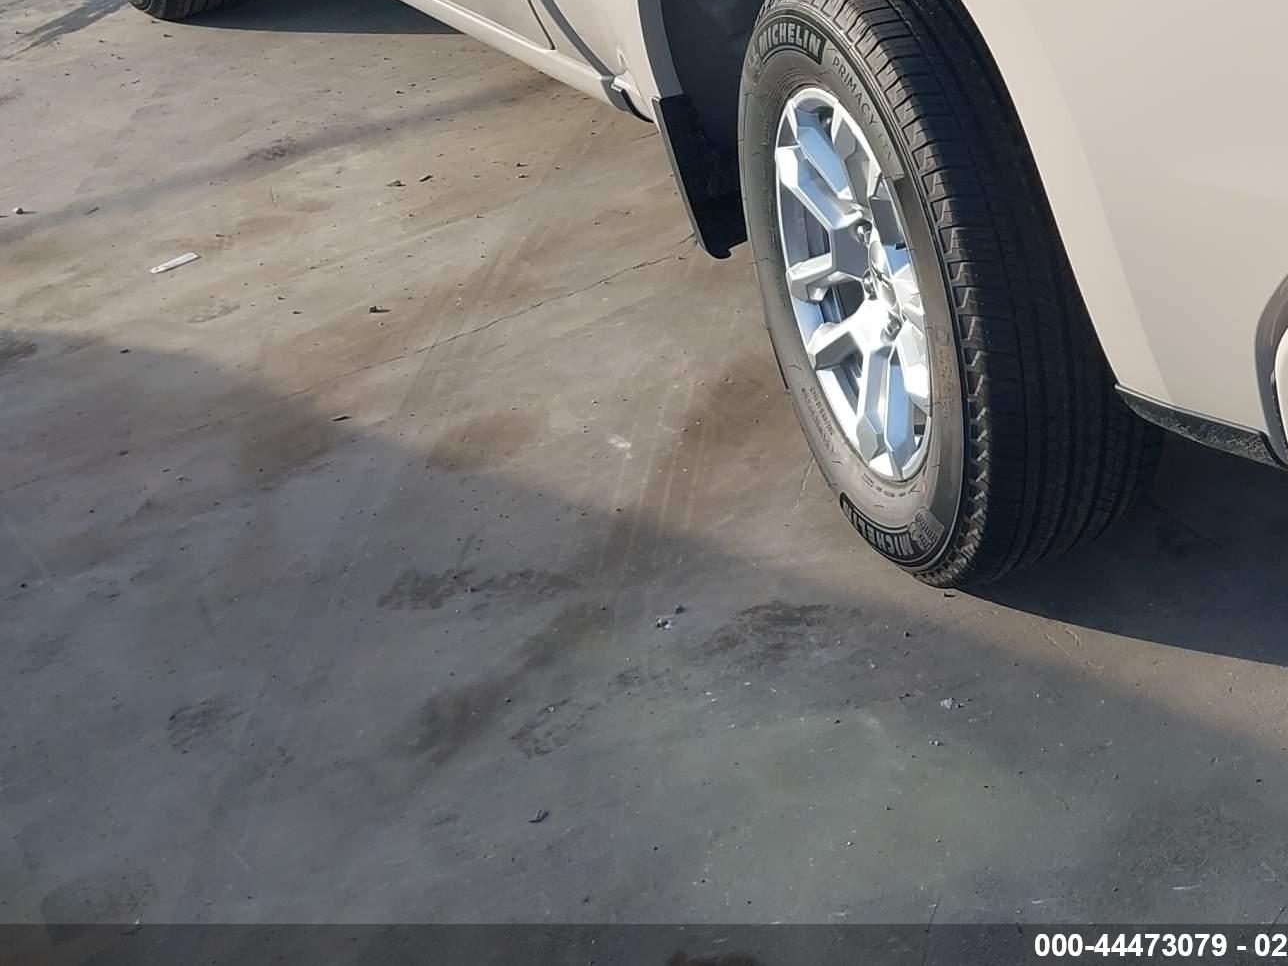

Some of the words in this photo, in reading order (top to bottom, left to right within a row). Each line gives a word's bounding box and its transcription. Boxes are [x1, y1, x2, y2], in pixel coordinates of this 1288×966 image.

[758, 22, 822, 59] MICHELIN
[832, 56, 878, 125] PRIMACY
[842, 499, 915, 556] MICHELIN
